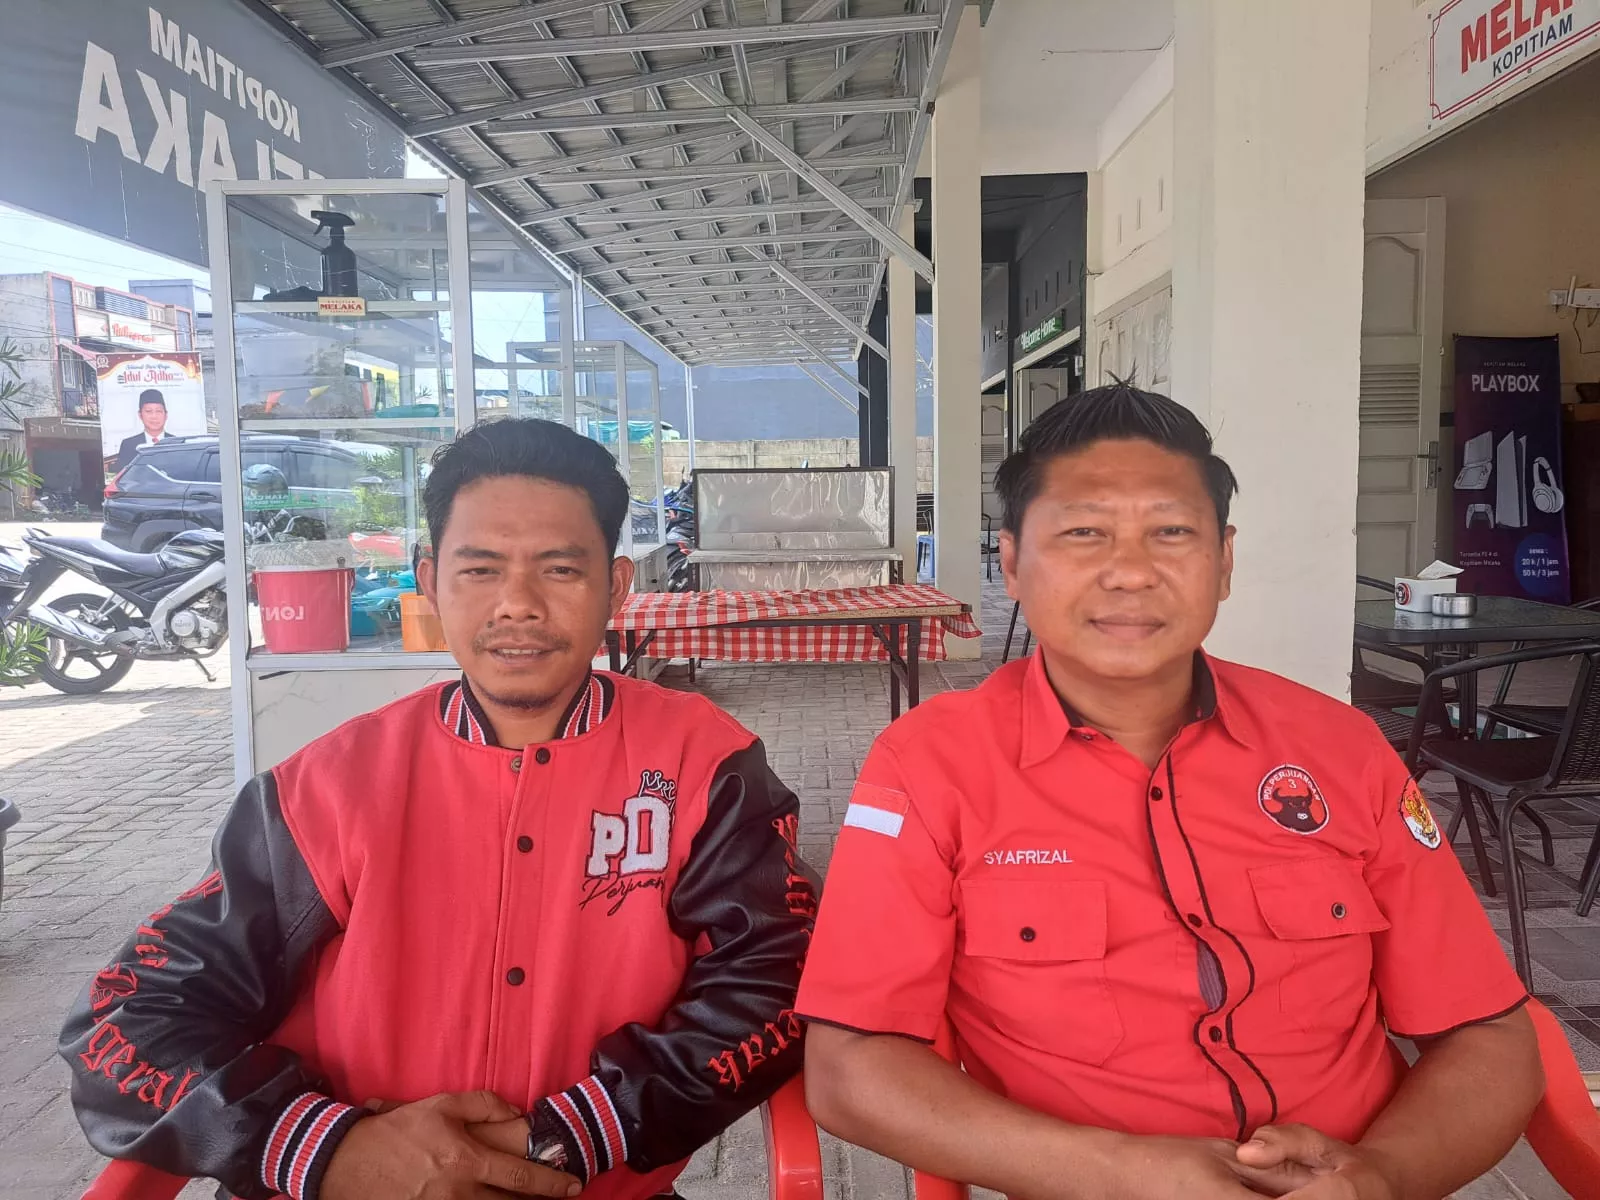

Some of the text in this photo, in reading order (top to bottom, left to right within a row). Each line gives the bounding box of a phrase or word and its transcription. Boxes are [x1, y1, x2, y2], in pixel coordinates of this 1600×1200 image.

[1461, 0, 1573, 74] MELA
[1492, 13, 1573, 77] KOPITIAM
[1040, 317, 1056, 340] Home
[1471, 374, 1540, 392] PLAYBOX
[1288, 779, 1297, 788] 3
[984, 849, 1074, 865] SYAFRIZAL
